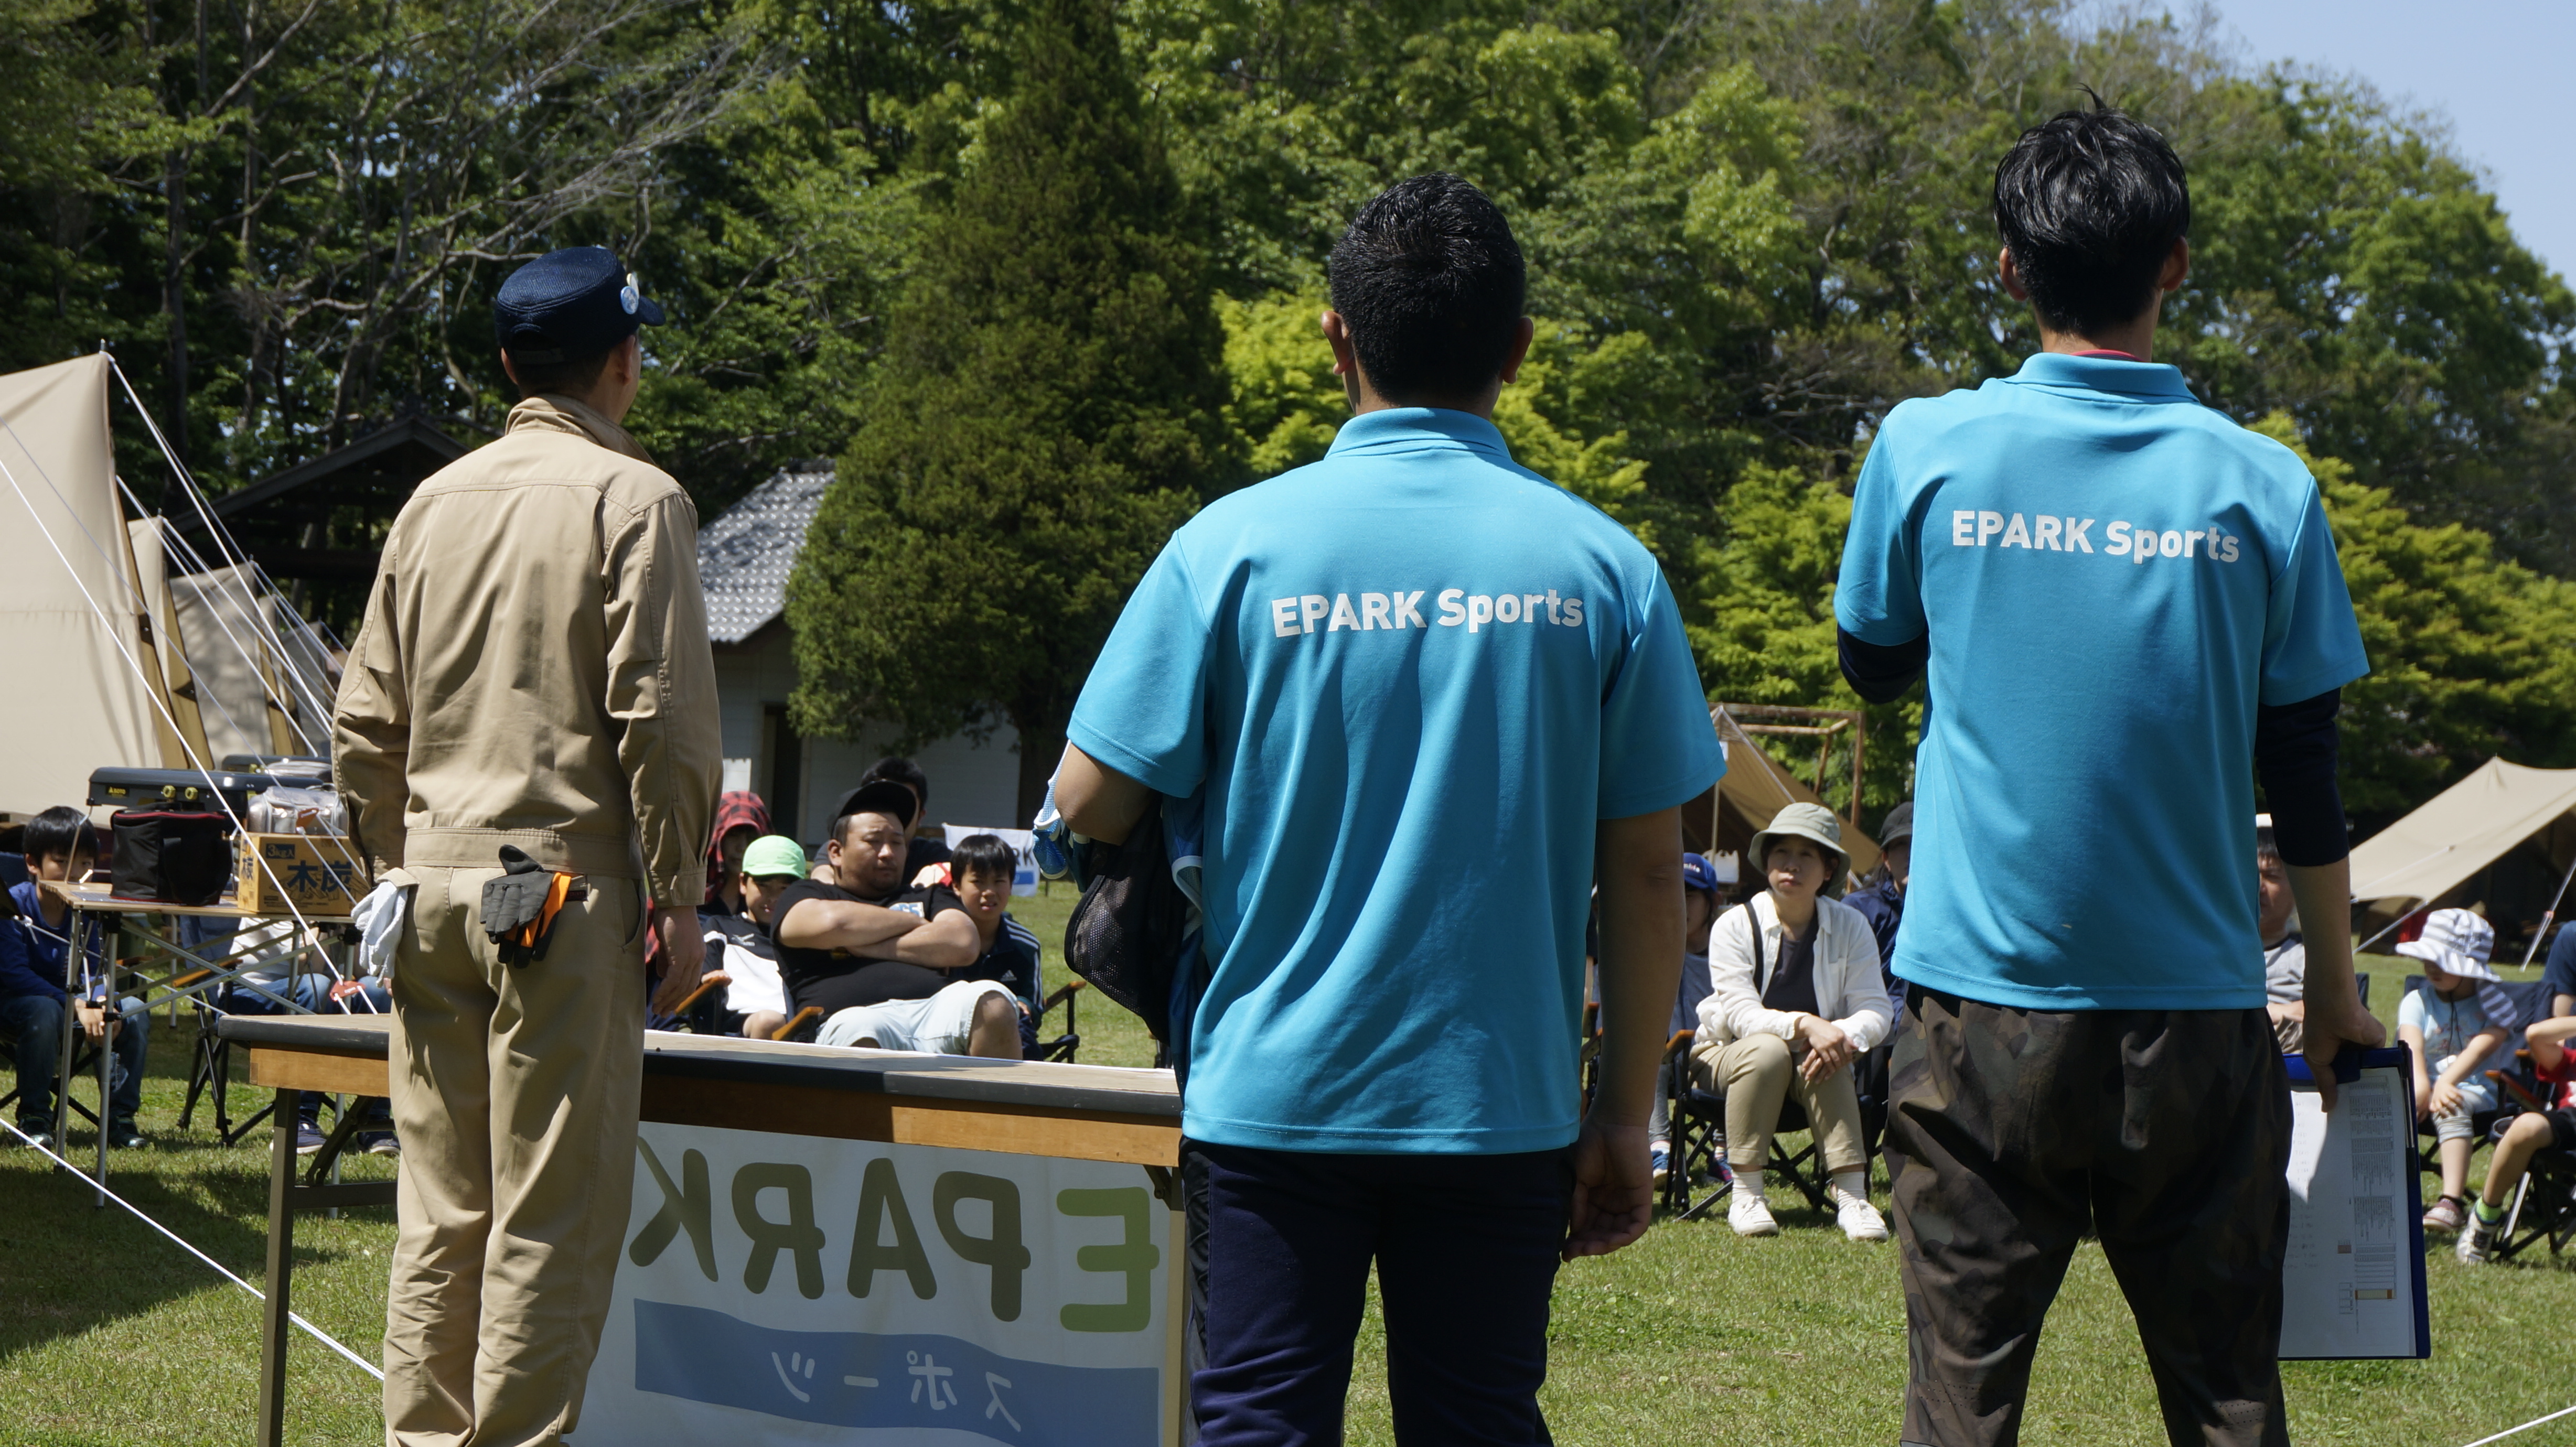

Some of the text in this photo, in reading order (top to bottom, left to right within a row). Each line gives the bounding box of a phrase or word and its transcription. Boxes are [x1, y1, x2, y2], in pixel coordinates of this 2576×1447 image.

[1952, 510, 2239, 565] EPARK Sports
[1272, 589, 1583, 638] EPARK Sports
[287, 860, 352, 893] 木炭
